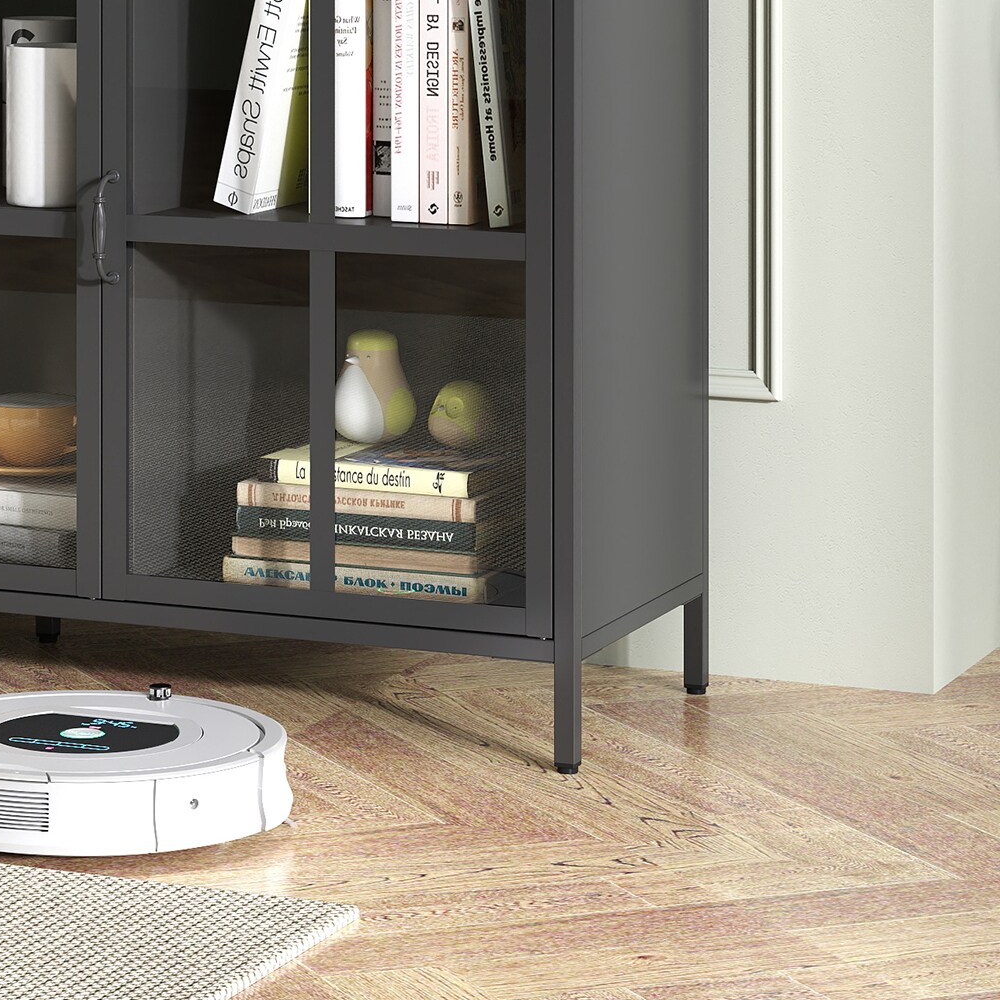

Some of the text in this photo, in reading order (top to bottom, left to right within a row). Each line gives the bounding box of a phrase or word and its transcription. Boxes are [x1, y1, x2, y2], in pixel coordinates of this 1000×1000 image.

[296, 461, 306, 479] La
[367, 467, 379, 485] du
[382, 468, 411, 488] destin
[244, 567, 467, 597] АЛЕКСА БЛОК ПОЭМЫ
